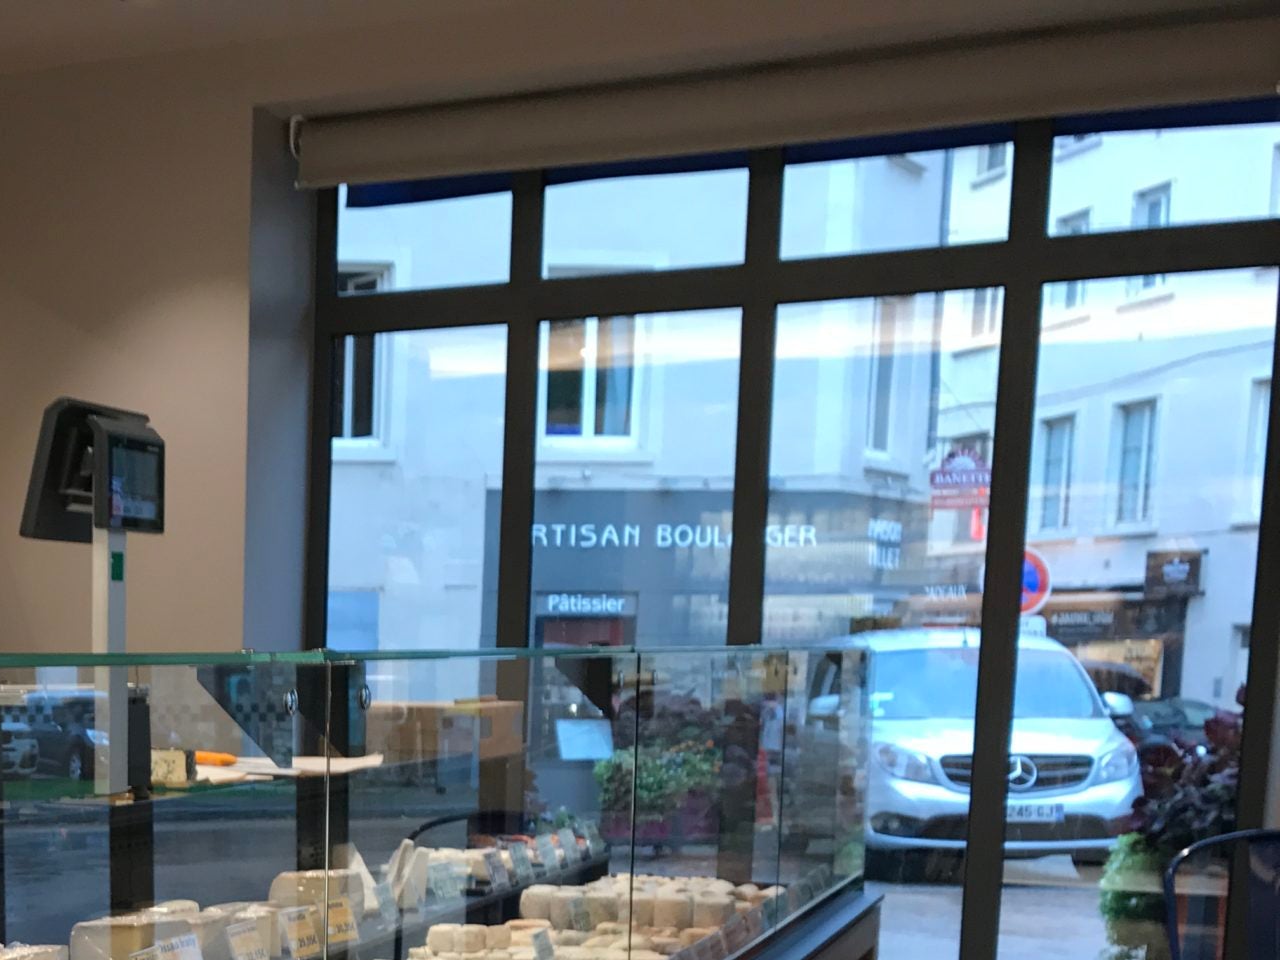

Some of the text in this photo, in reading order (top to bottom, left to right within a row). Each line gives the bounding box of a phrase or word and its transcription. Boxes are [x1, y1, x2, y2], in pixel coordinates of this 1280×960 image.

[531, 523, 818, 547] RTISAN BOULGER
[548, 594, 626, 612] Pâtissier
